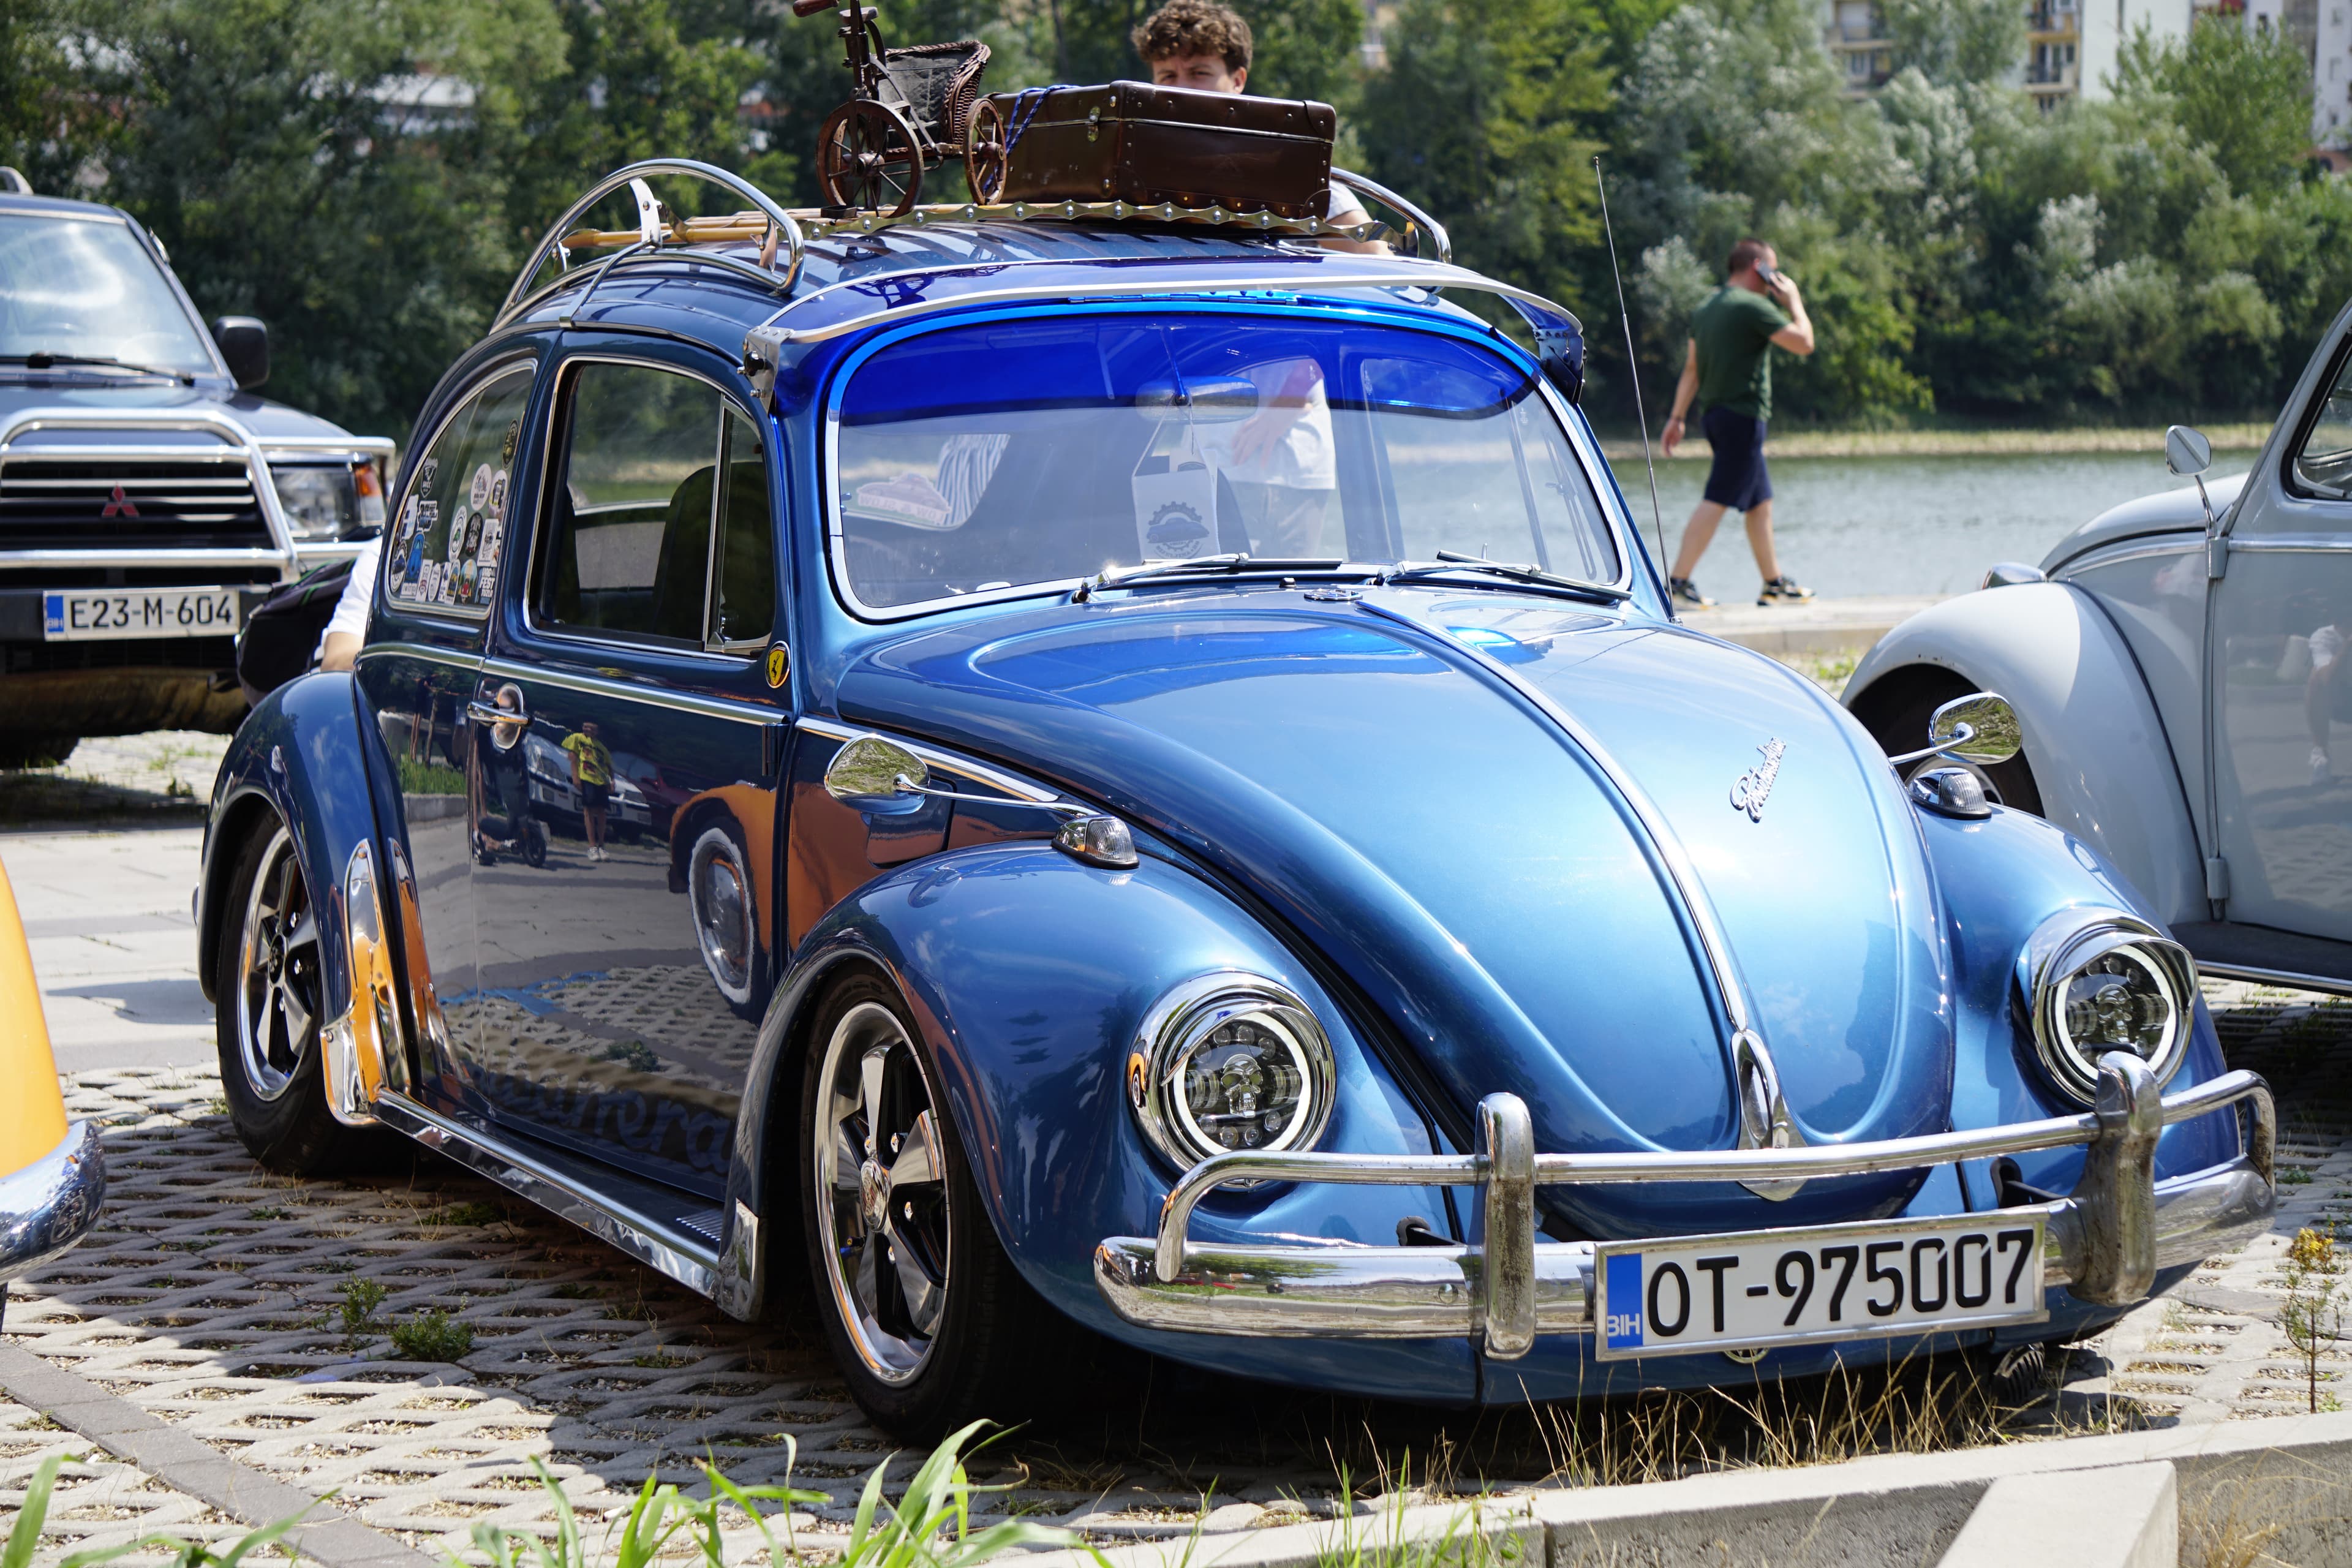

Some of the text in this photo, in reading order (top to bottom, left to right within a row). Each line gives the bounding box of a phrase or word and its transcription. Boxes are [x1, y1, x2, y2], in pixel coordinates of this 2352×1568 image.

[480, 577, 496, 589] FEST
[47, 617, 64, 629] BIH
[70, 595, 233, 629] E23-M-604
[1647, 1229, 2034, 1337] OT-975007
[1607, 1313, 1641, 1337] BIH
